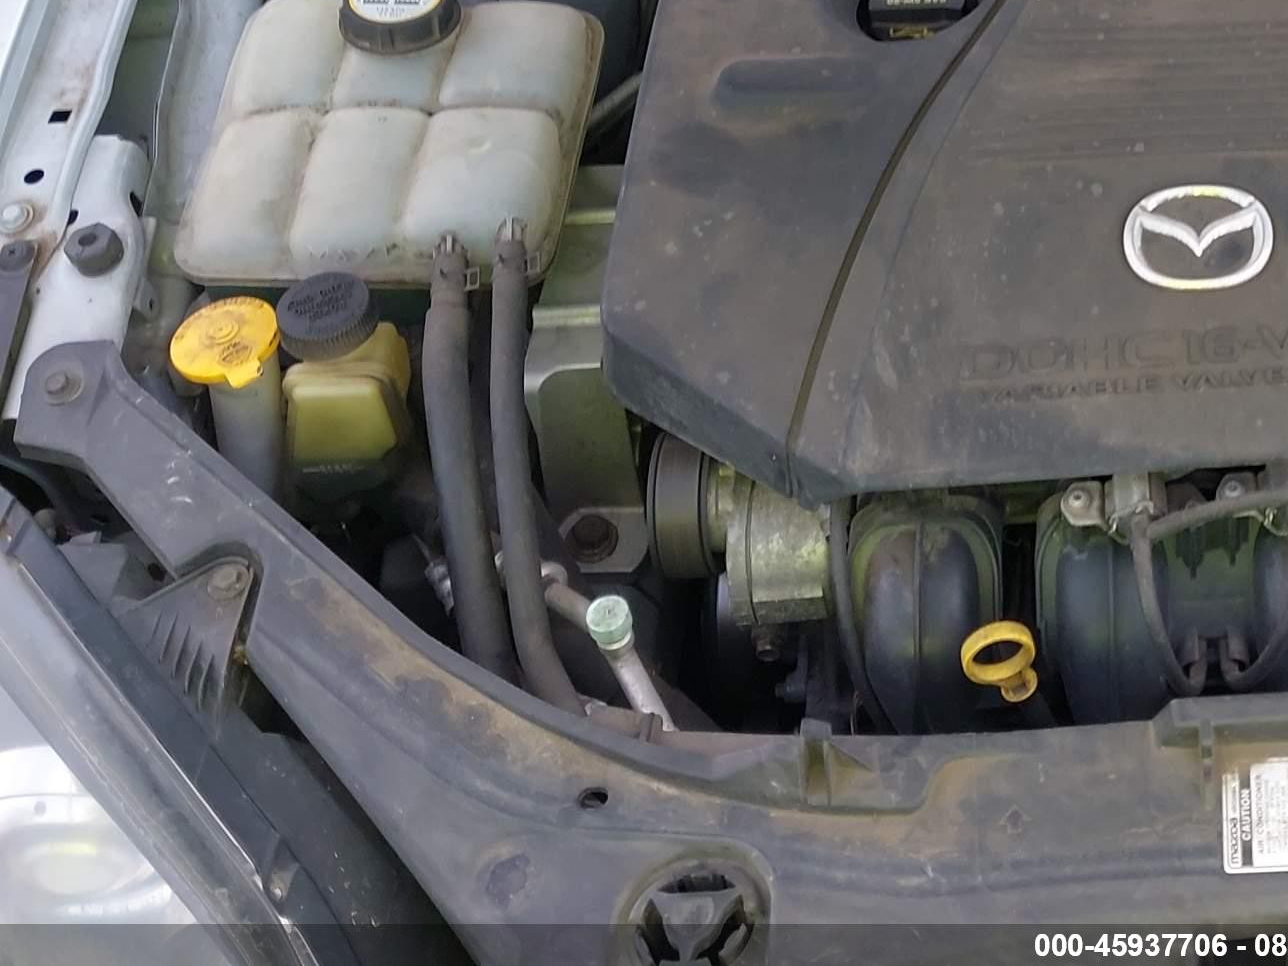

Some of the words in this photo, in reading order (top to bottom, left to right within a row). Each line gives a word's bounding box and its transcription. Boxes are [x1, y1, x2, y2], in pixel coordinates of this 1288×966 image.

[960, 332, 1176, 379] DOHC
[977, 375, 1161, 404] VARIABLE
[1177, 367, 1288, 392] VALVE
[1240, 788, 1252, 842] CAUTION
[1255, 773, 1264, 835] CONDITIONER
[1228, 817, 1240, 864] mazda
